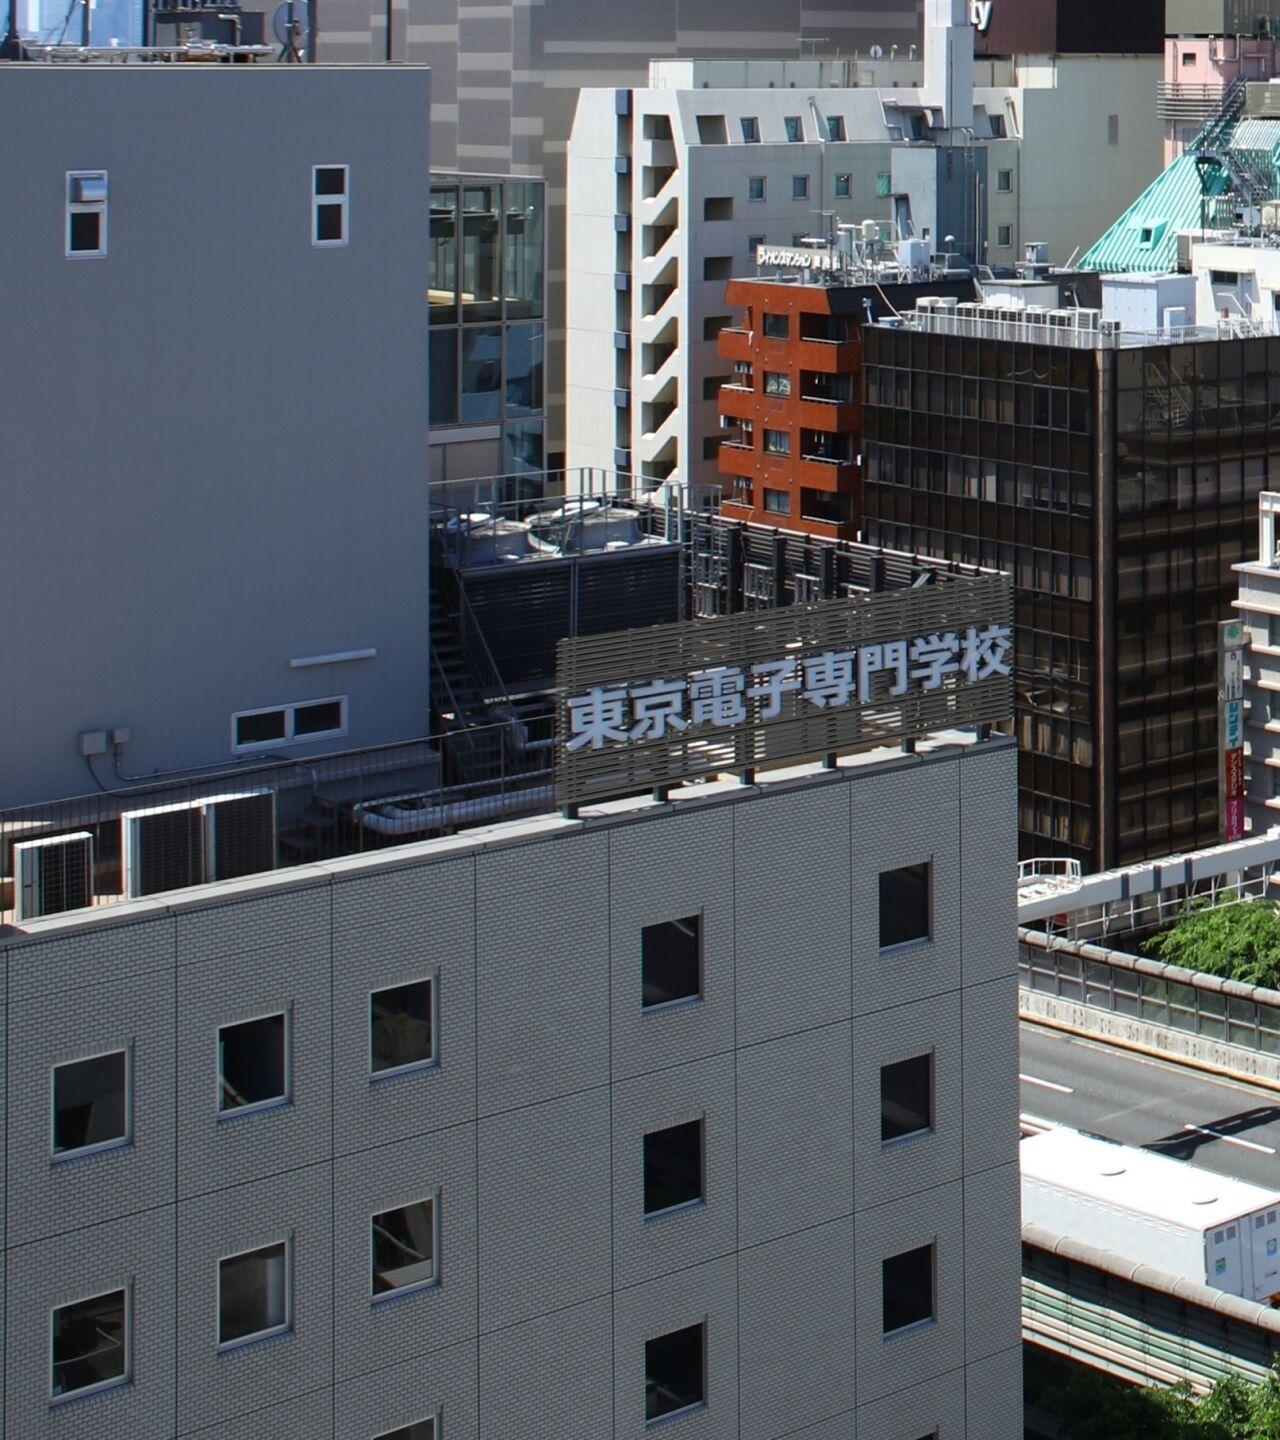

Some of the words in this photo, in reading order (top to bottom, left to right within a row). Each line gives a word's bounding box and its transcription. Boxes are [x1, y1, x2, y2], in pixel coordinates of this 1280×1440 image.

[565, 624, 1012, 752] 東京電子専門学校
